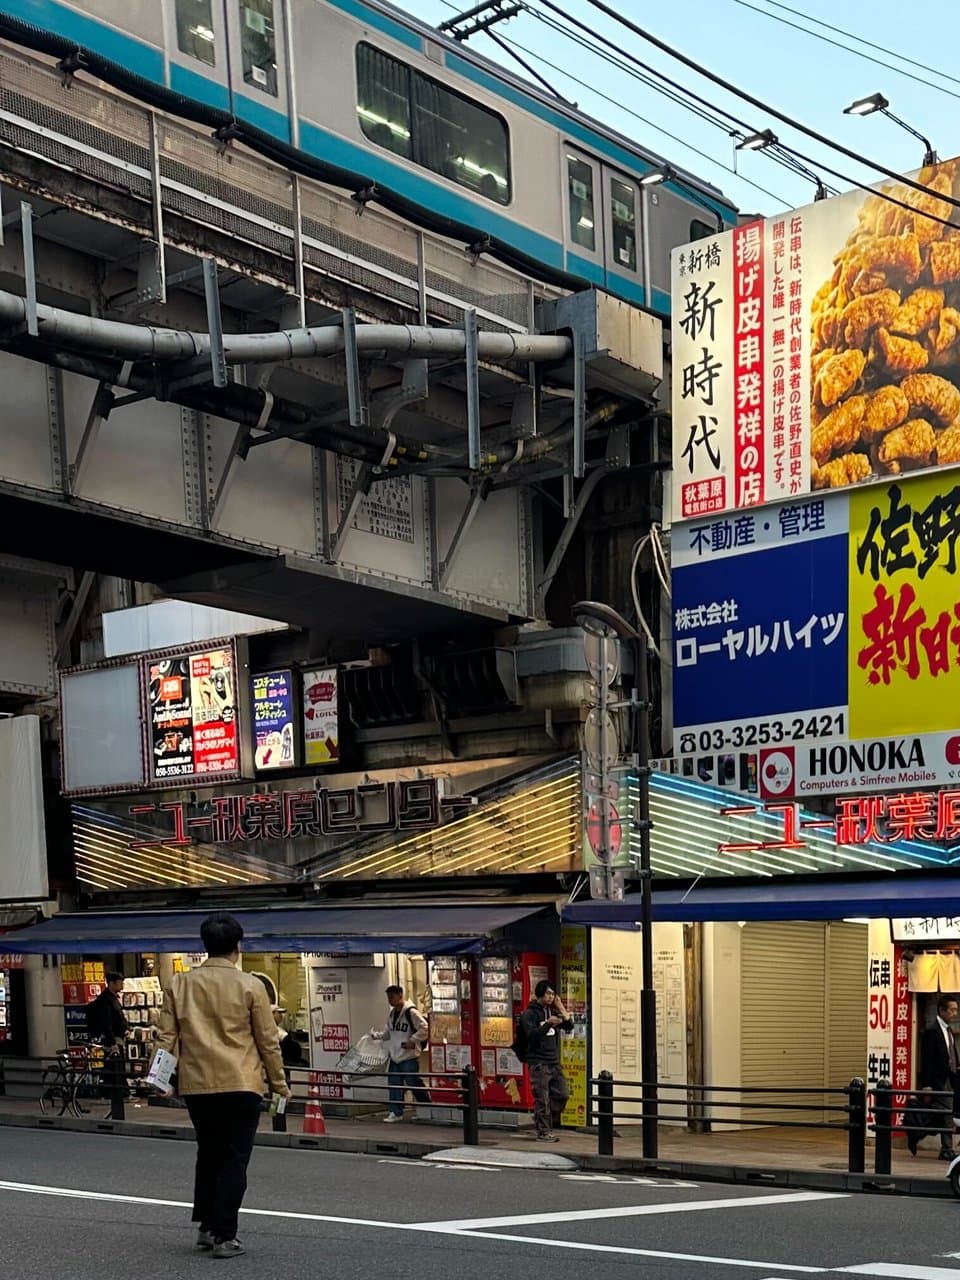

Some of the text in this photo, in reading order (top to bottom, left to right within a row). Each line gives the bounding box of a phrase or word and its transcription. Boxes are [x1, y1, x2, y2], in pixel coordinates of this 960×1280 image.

[687, 244, 722, 274] 新橋
[736, 226, 762, 508] 揚げ皮串発祥の店
[789, 217, 803, 495] 伝串は、新時代創業者の佐野直史が
[678, 281, 724, 474] 新時代
[684, 479, 723, 504] 秋葉原
[689, 500, 826, 556] 不動産・管理
[675, 599, 738, 631] 株式会社
[676, 611, 845, 668] ローヤルハイツ
[699, 712, 846, 752] 03-3253-2421
[808, 738, 926, 777] HONOKA
[800, 769, 937, 792] Computers & Simfree Mobiles
[128, 778, 478, 850] ニュー秋葉原センター
[869, 957, 891, 988] 伝串
